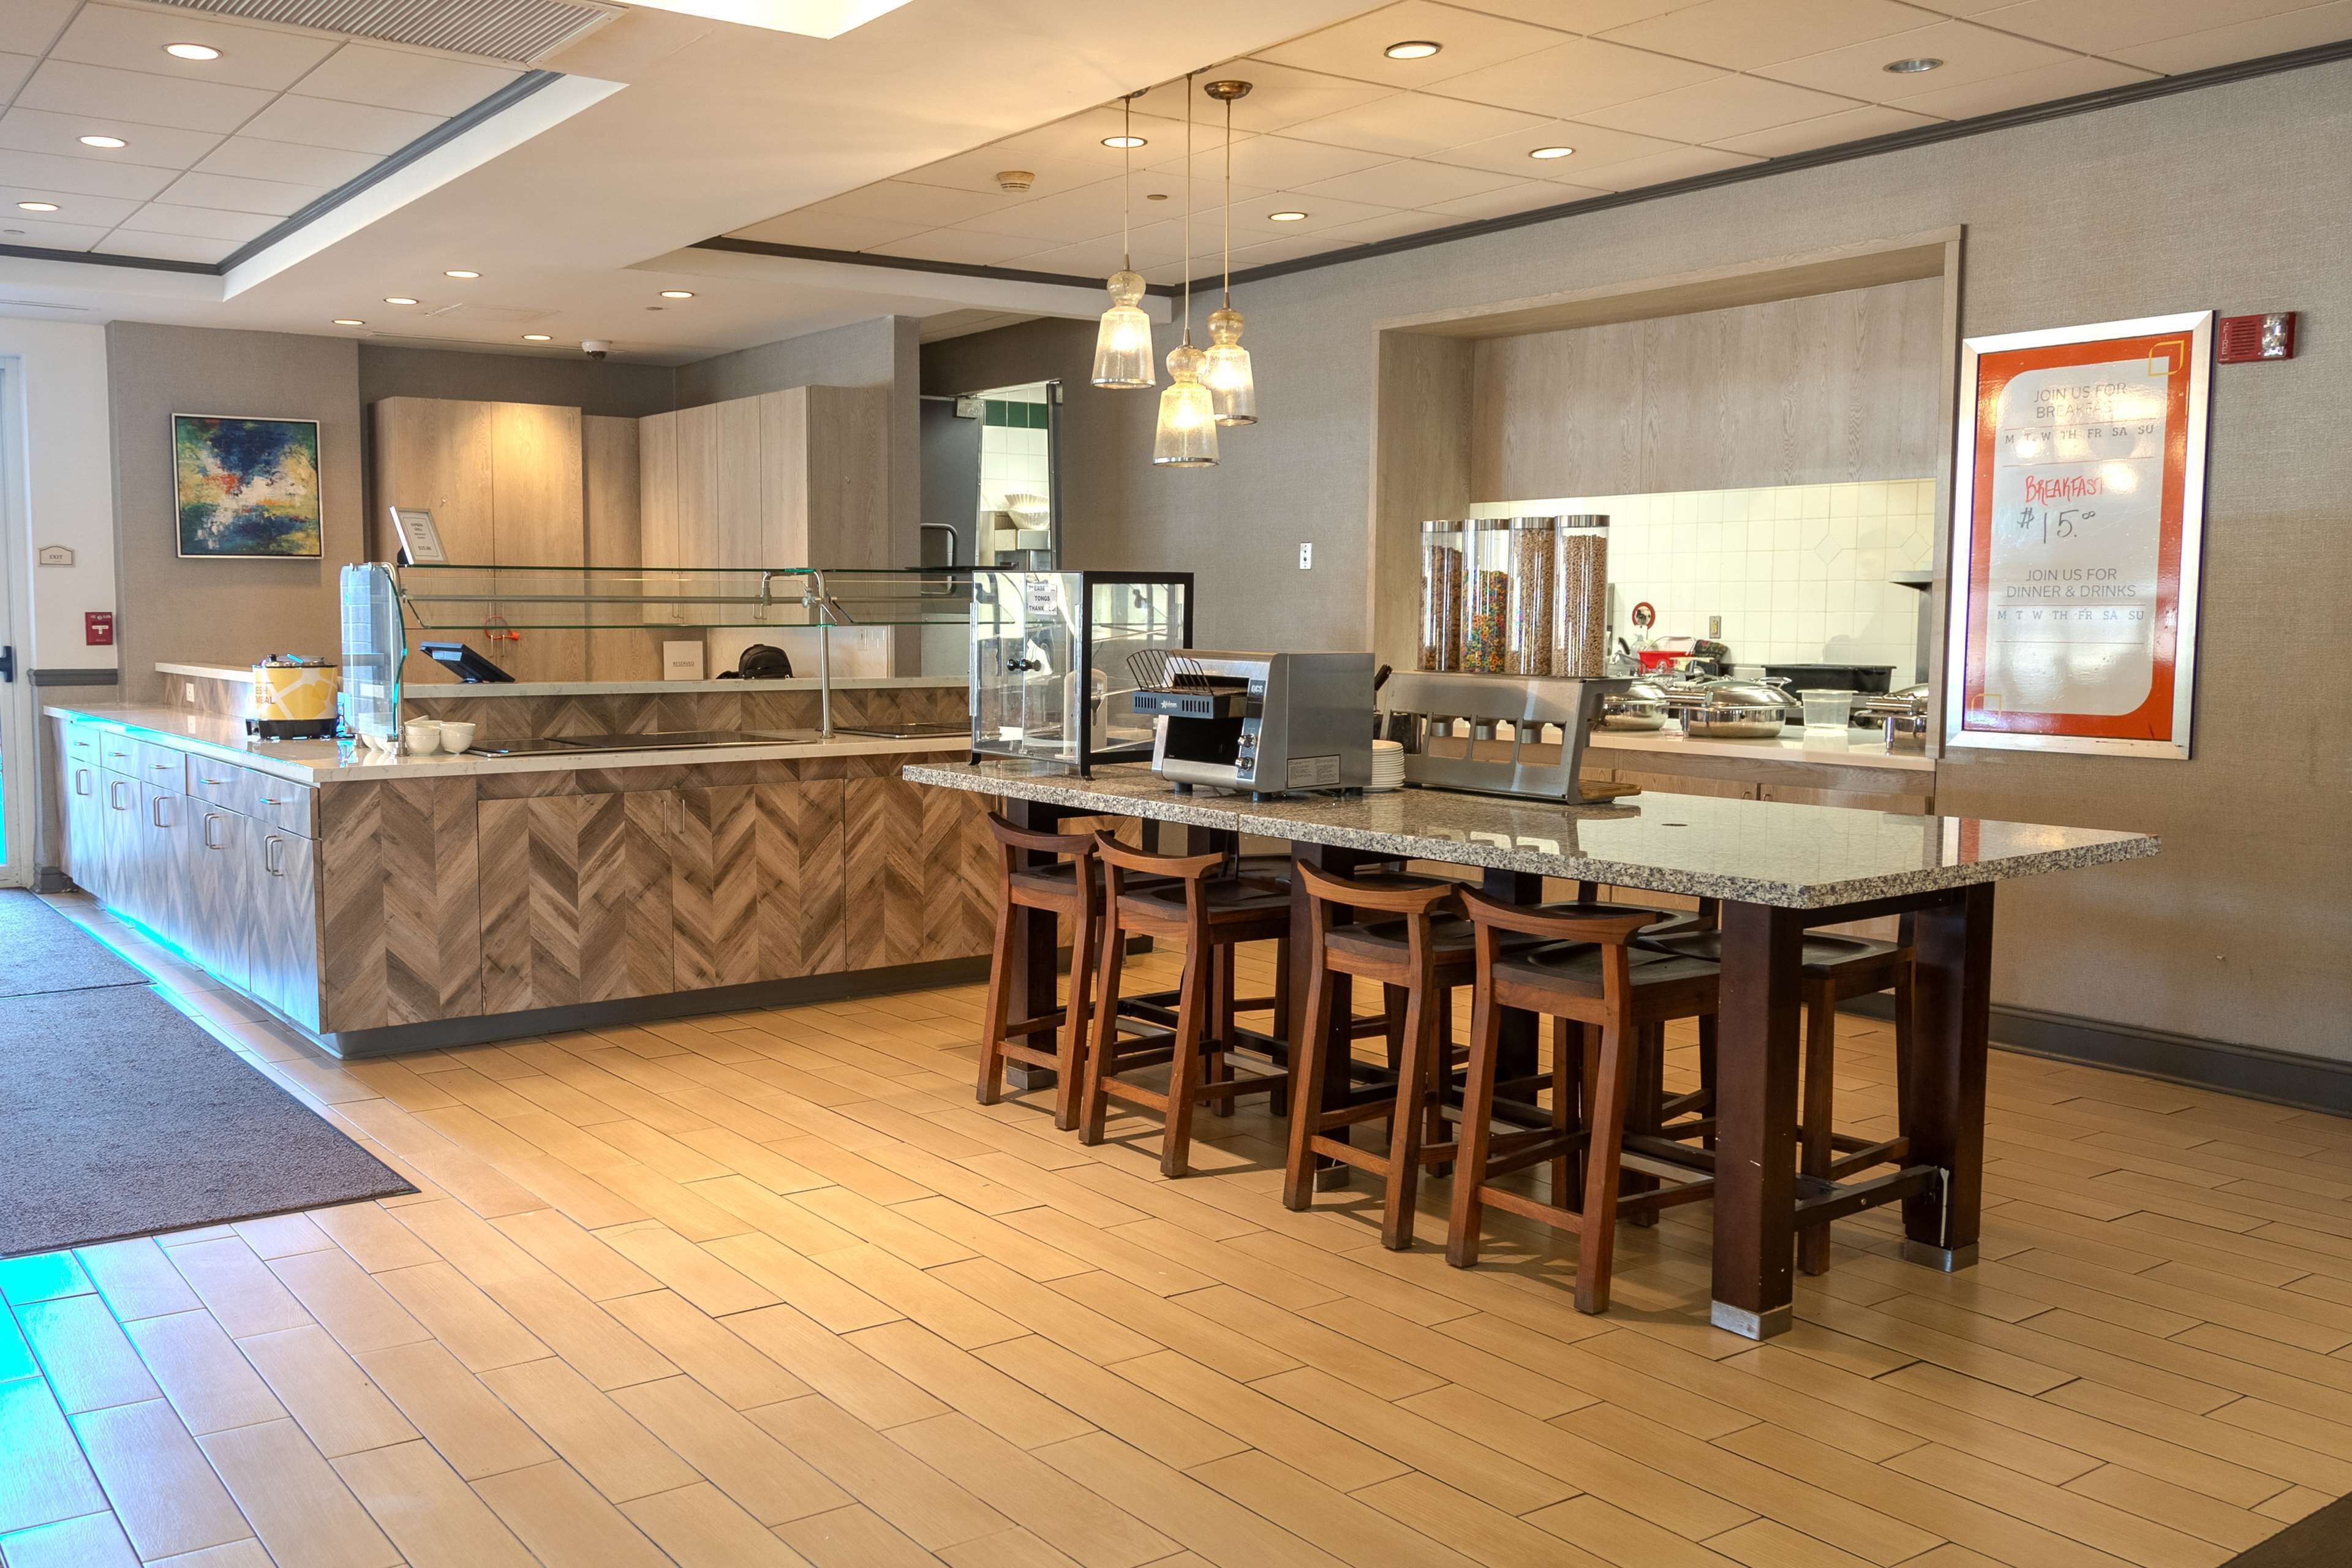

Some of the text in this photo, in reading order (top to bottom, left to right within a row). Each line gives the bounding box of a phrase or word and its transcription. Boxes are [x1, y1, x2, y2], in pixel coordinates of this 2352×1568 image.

[2034, 382, 2127, 402] JOIN US FOR
[2036, 400, 2114, 419] BREAKFAS
[2005, 435, 2015, 444] M
[2041, 432, 2051, 441] W
[2060, 430, 2077, 440] TH
[2087, 428, 2102, 438] FR
[2112, 427, 2127, 437] SA
[2138, 424, 2154, 435] SU
[2025, 475, 2103, 506] BREAKFAST
[2026, 568, 2117, 581] JOIN US FOR
[2007, 584, 2136, 598] DINNER & DRINKS
[1997, 611, 2144, 620] M T W TH FR SA SU
